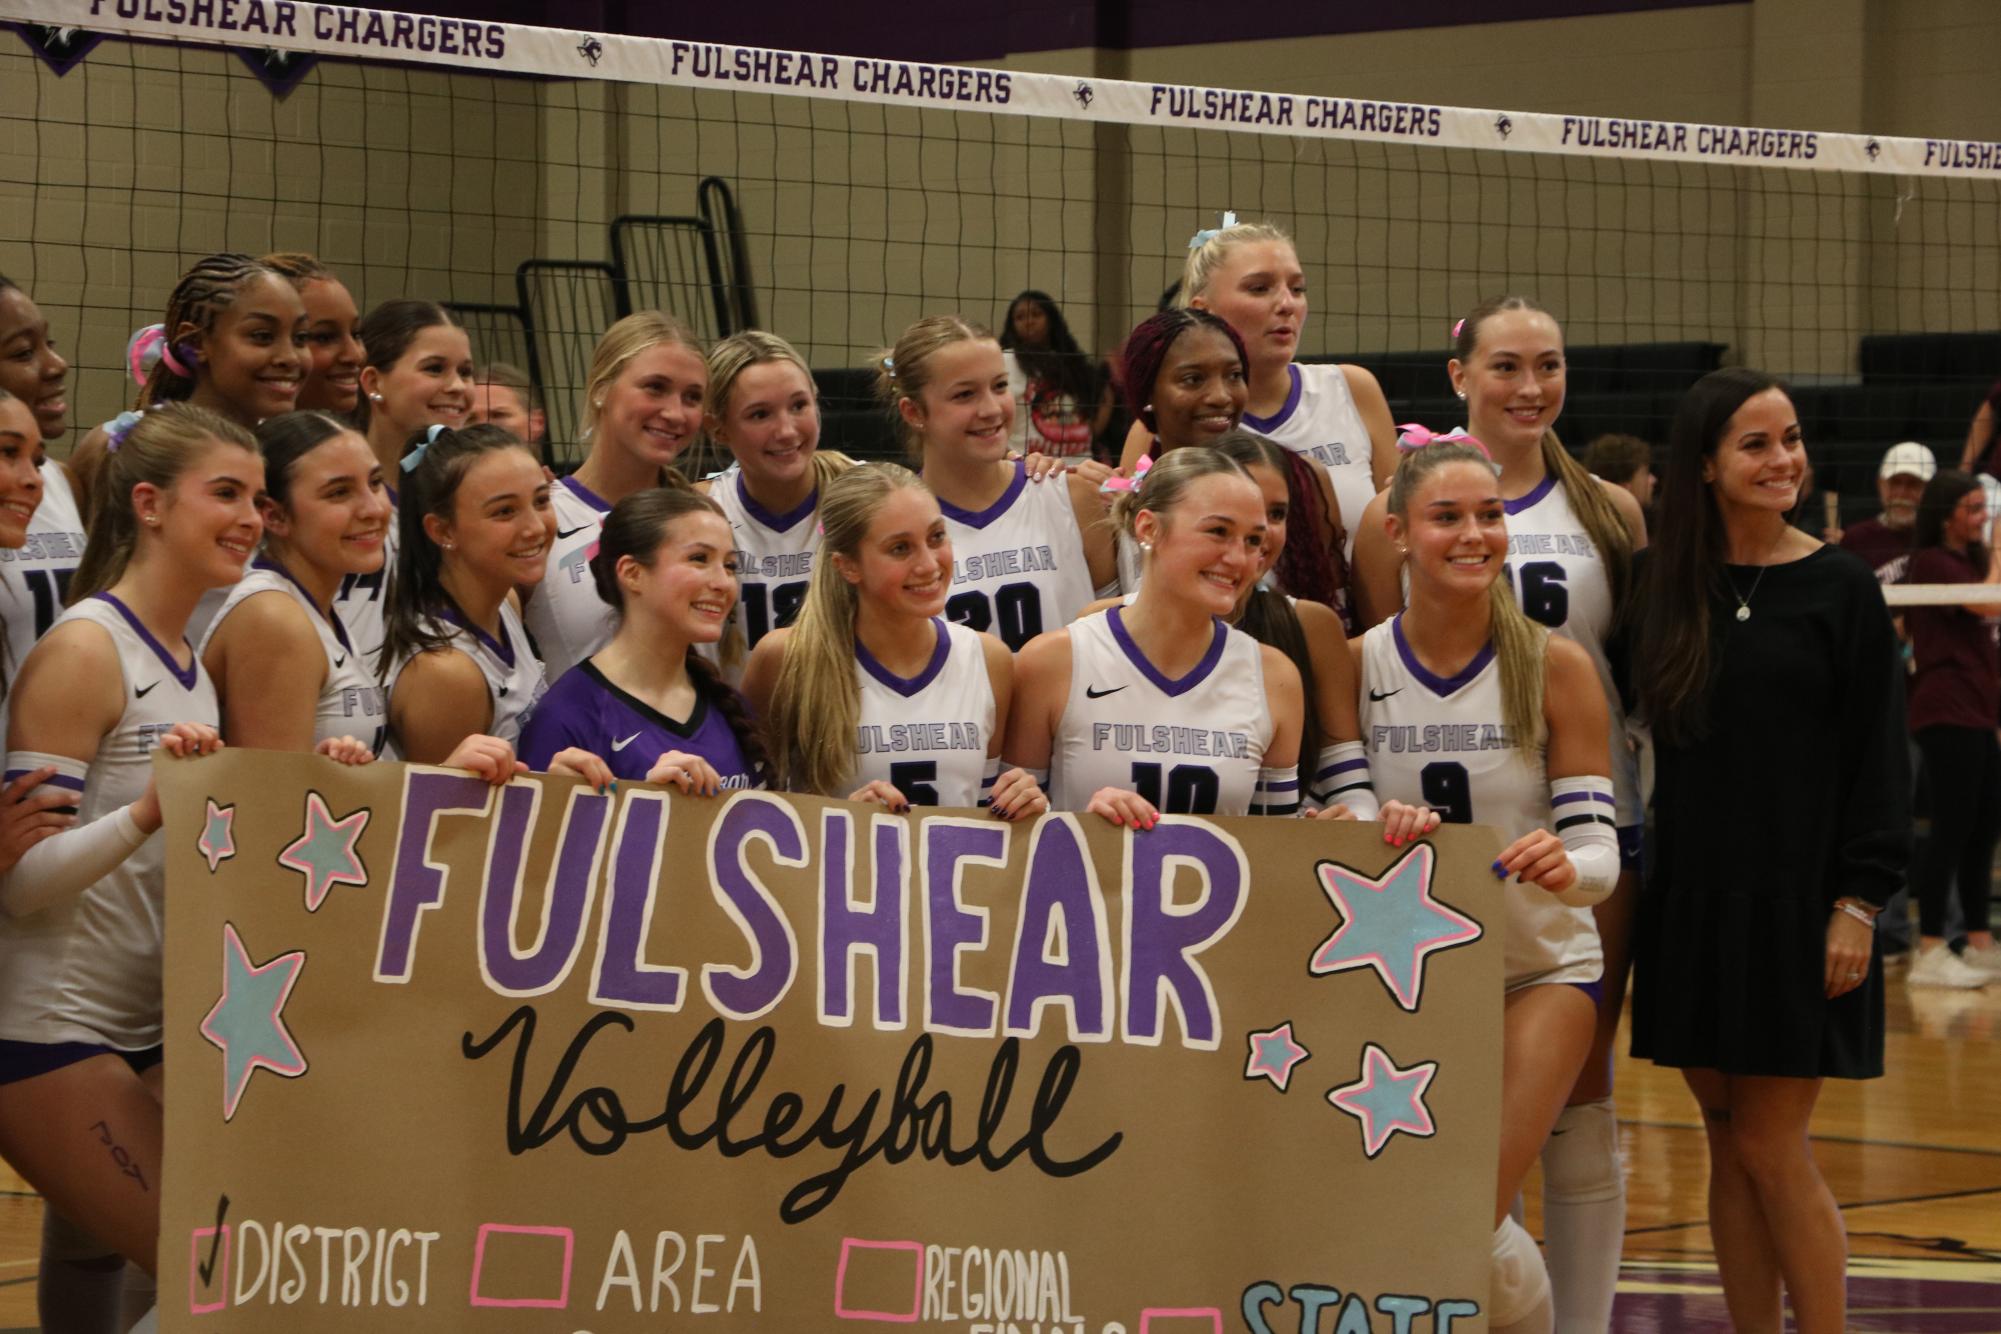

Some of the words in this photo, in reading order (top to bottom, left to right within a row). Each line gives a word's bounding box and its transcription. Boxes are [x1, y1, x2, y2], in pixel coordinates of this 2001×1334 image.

[314, 10, 505, 59] CHARGERS
[672, 42, 838, 89] FULSHEAR
[853, 60, 1011, 104] CHARGERS
[1150, 85, 1294, 127] FULSHEAR
[1305, 97, 1441, 137] CHARGERS
[1562, 118, 1687, 152] FULSHEAR
[1698, 127, 1818, 160] CHARGERS
[953, 545, 1057, 585] LSHEAR
[1503, 561, 1569, 628] 6
[856, 722, 981, 755] ULSHEAR
[1093, 722, 1250, 759] FULSHEAR
[890, 760, 938, 806] 5
[1131, 761, 1220, 815] 10
[1420, 761, 1473, 824] 9
[373, 767, 1250, 1051] FULSHEAR
[462, 1004, 1123, 1225] Volleyball
[234, 1219, 440, 1307] DISTRICT
[595, 1228, 762, 1313] AREA
[922, 1243, 1086, 1323] REGIONAL
